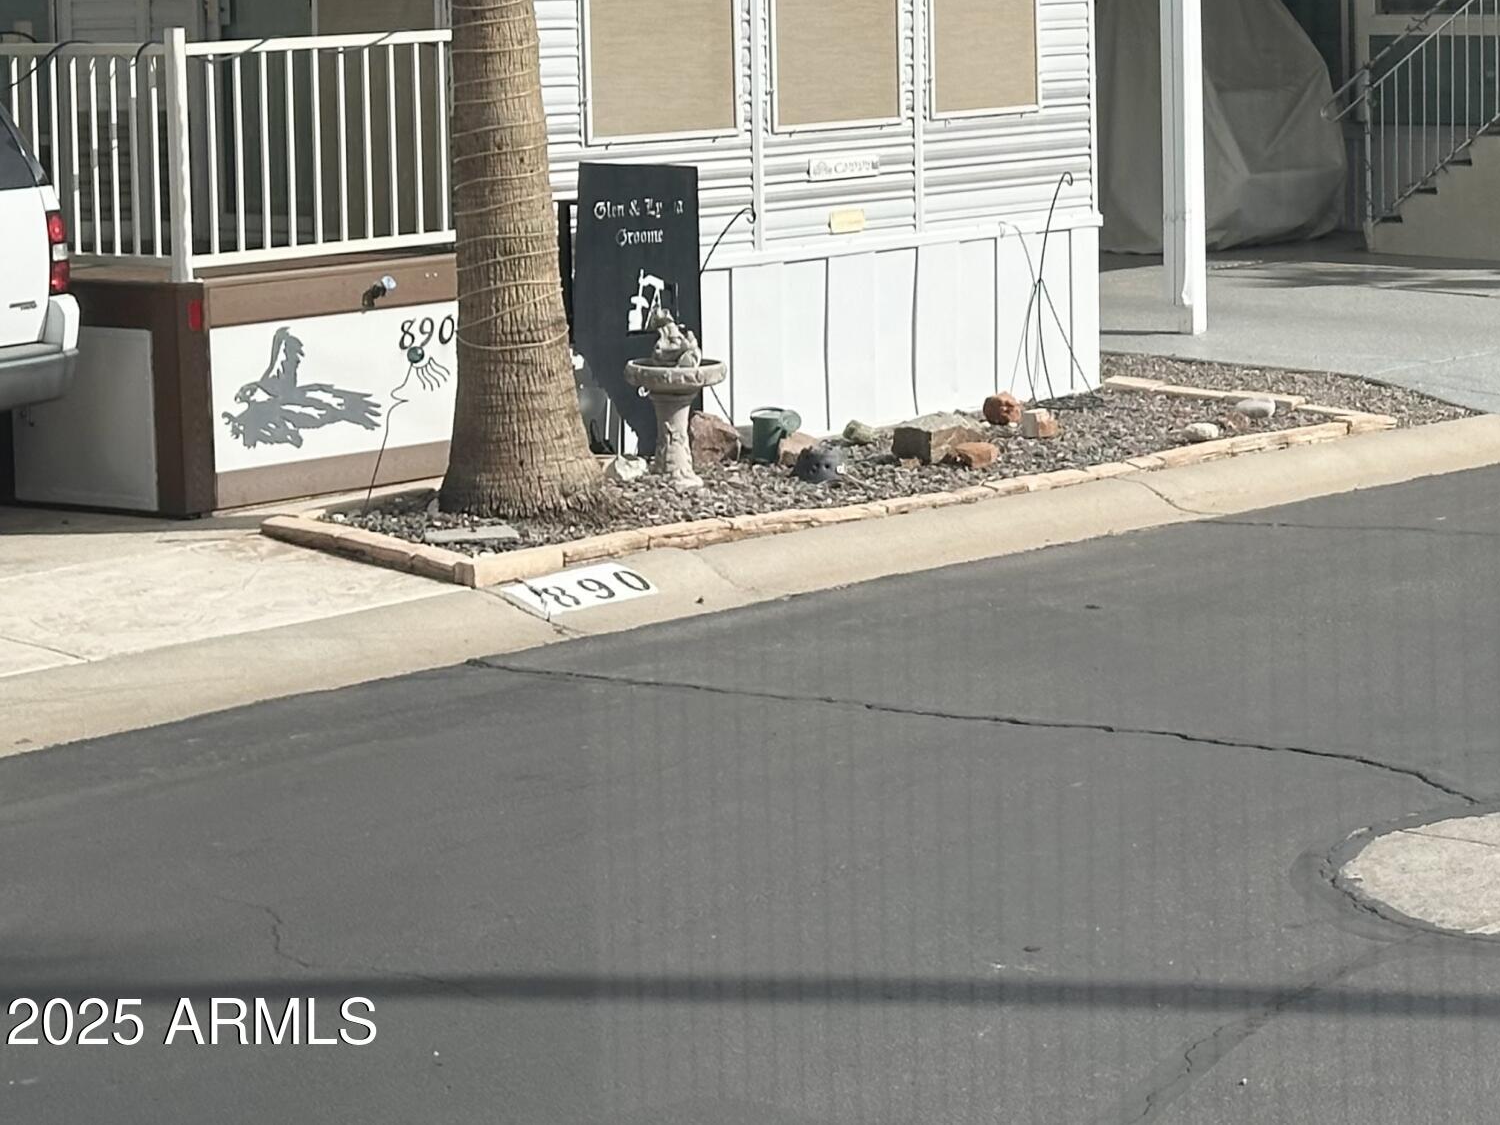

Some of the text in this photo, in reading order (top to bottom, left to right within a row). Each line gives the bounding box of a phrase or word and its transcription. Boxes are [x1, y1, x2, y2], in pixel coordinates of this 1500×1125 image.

[594, 201, 625, 220] Glen
[629, 199, 641, 216] &
[616, 228, 664, 247] Groome
[399, 315, 455, 350] 890
[541, 571, 651, 607] 890
